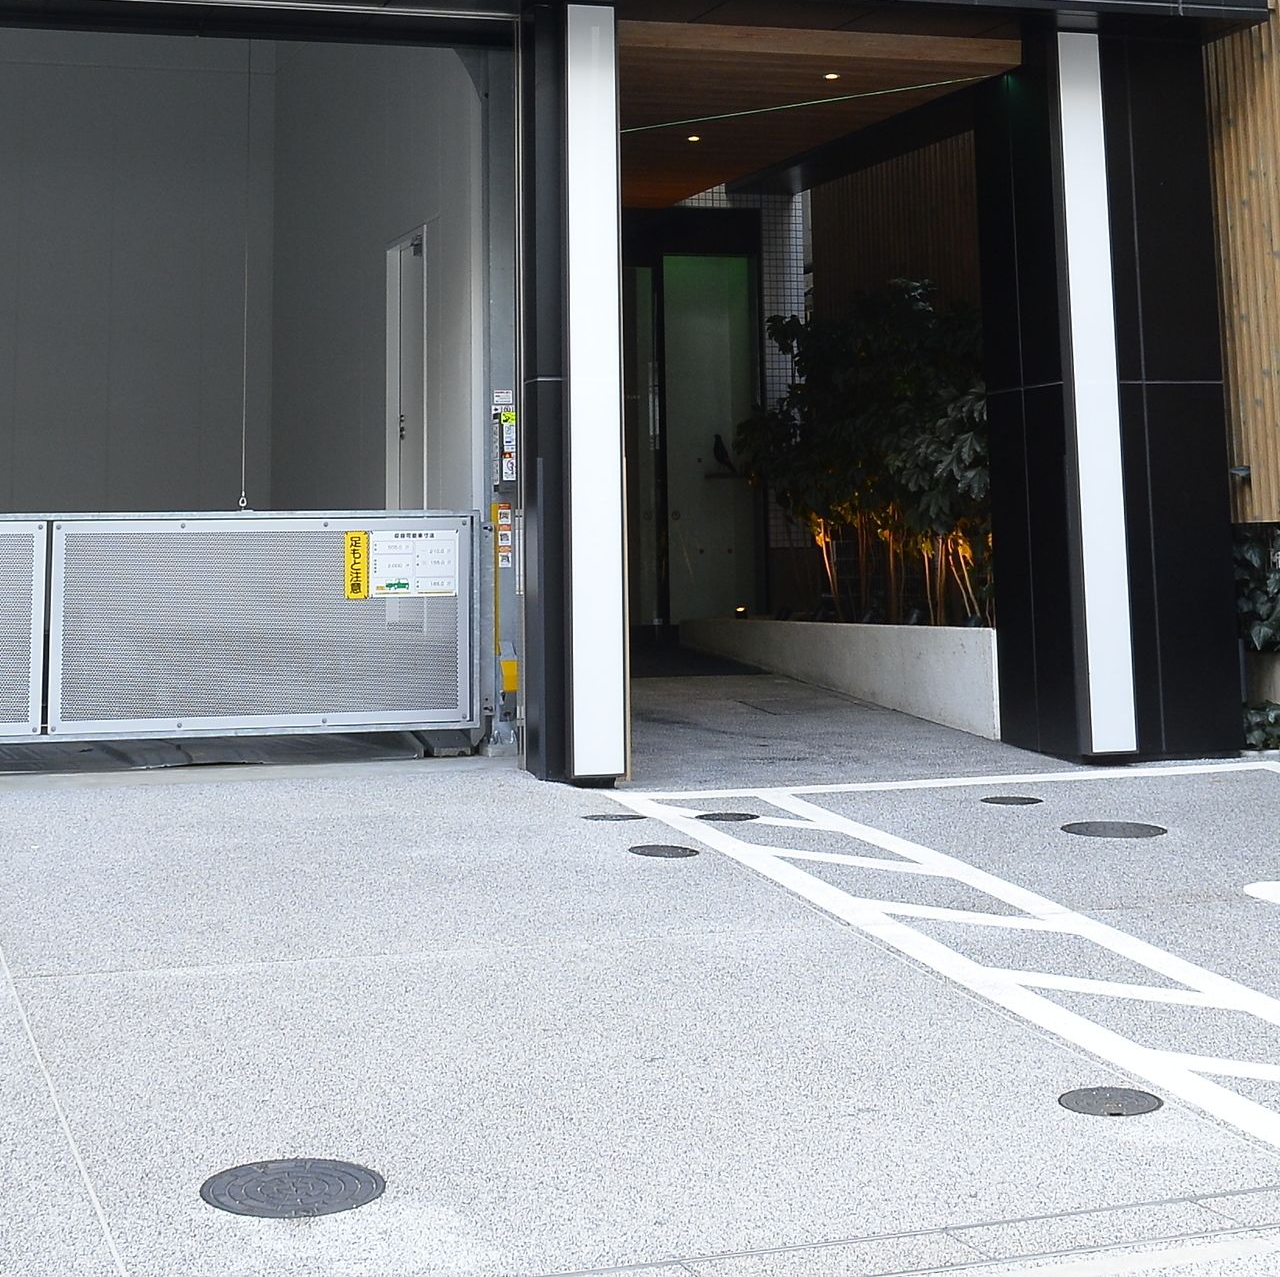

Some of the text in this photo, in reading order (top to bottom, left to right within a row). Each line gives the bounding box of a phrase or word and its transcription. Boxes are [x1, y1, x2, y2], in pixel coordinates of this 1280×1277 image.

[349, 536, 362, 594] 足もと注意
